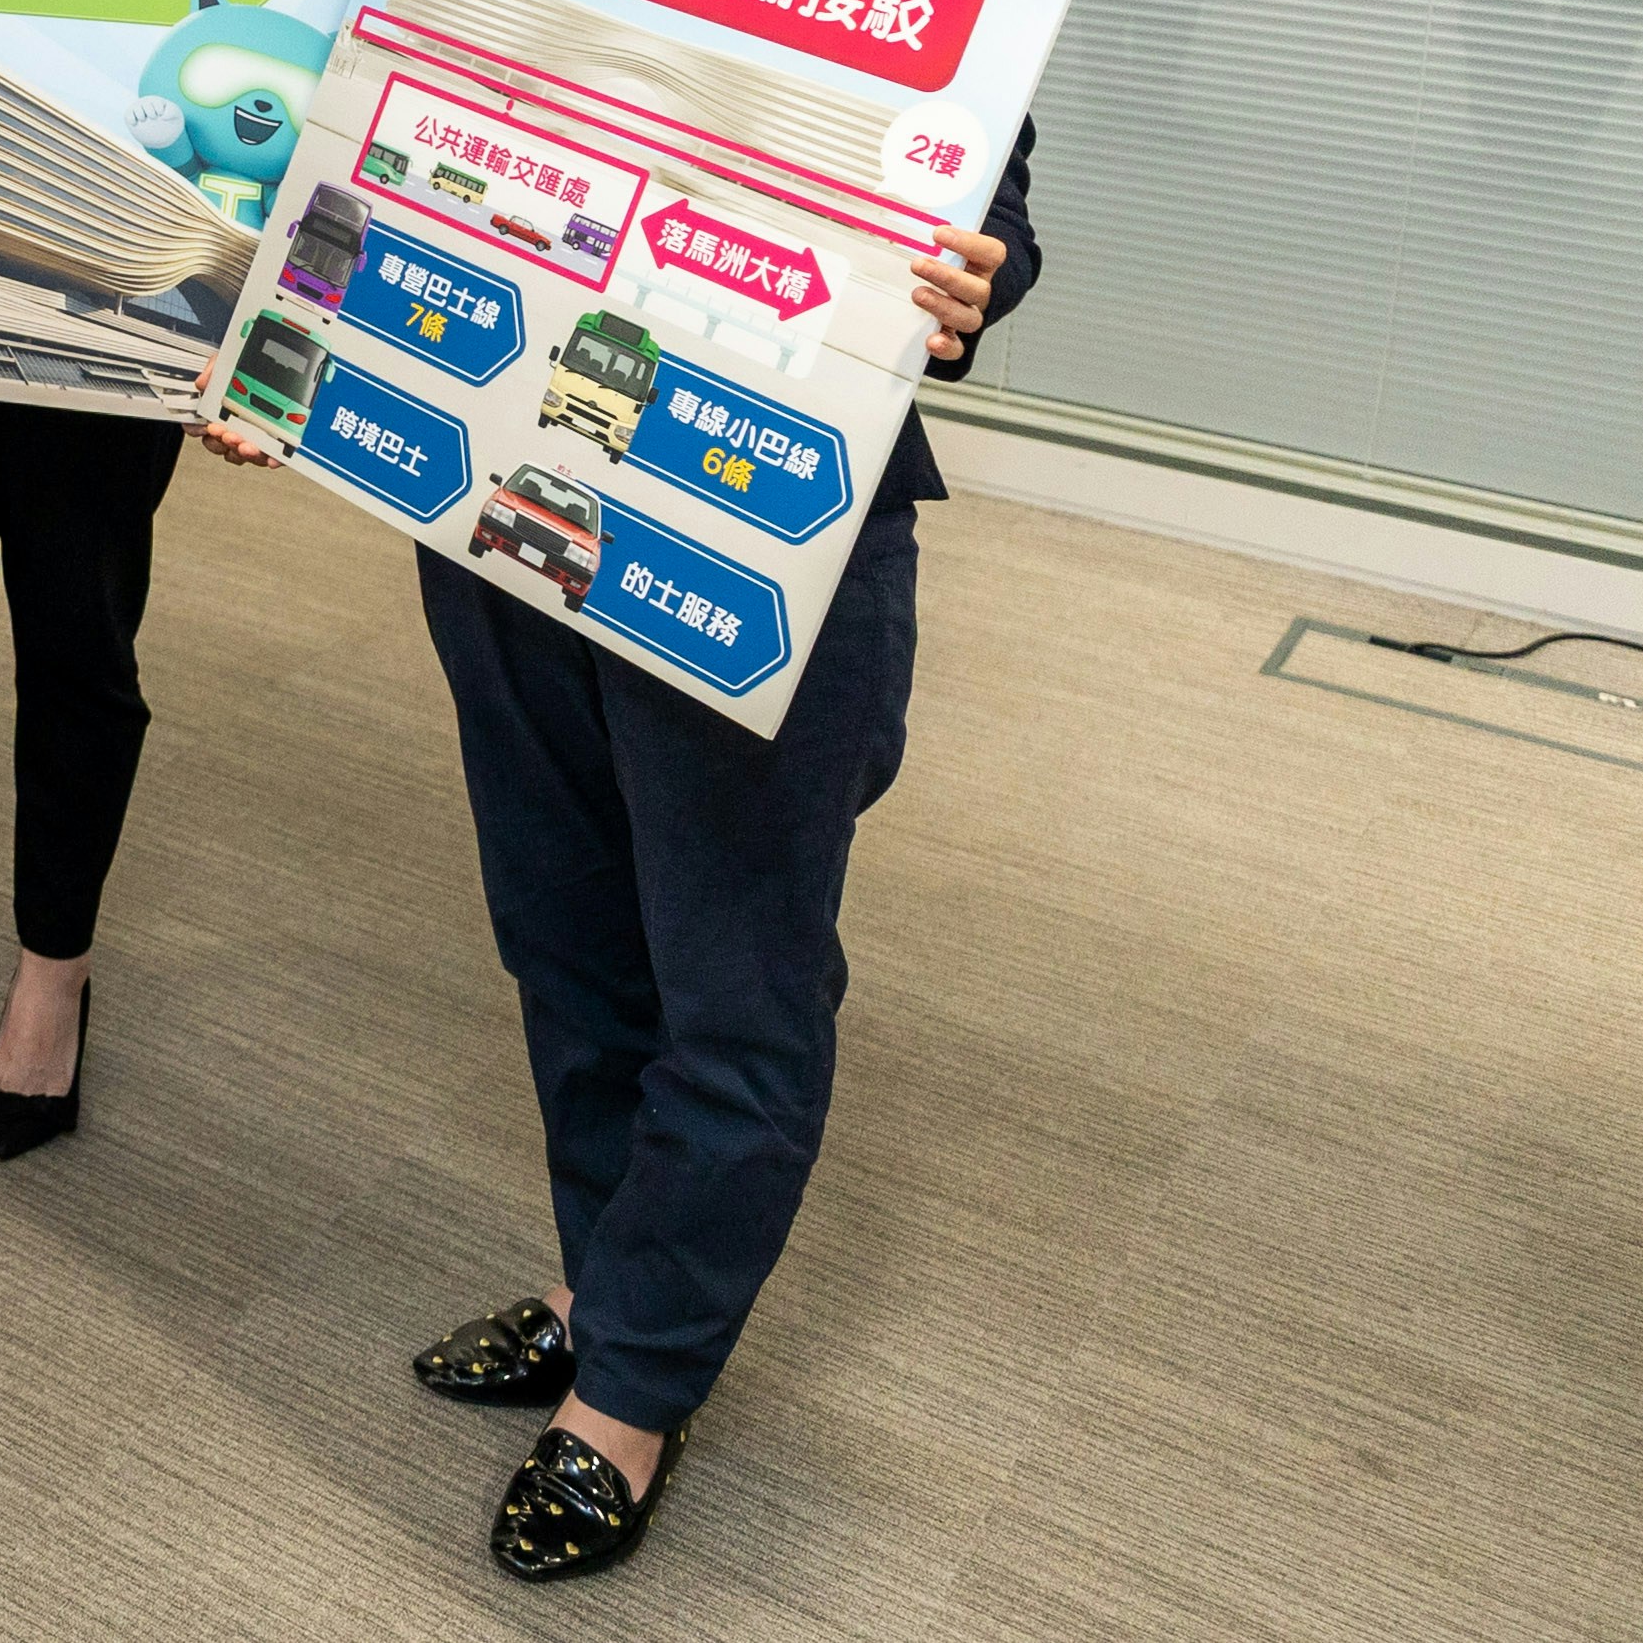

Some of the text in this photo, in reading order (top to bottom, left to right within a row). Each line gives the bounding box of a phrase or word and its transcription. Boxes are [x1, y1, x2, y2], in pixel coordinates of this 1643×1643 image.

[413, 114, 592, 209] 公共運輸交匯處
[904, 133, 968, 179] 2樓
[377, 252, 502, 331] 專營巴士線
[656, 217, 813, 305] 落馬洲大橋
[405, 302, 449, 344] 7條
[329, 405, 429, 478] 跨境巴士
[666, 386, 822, 481] 專線小巴線
[702, 447, 757, 493] 6條
[620, 561, 744, 648] 的士服務
